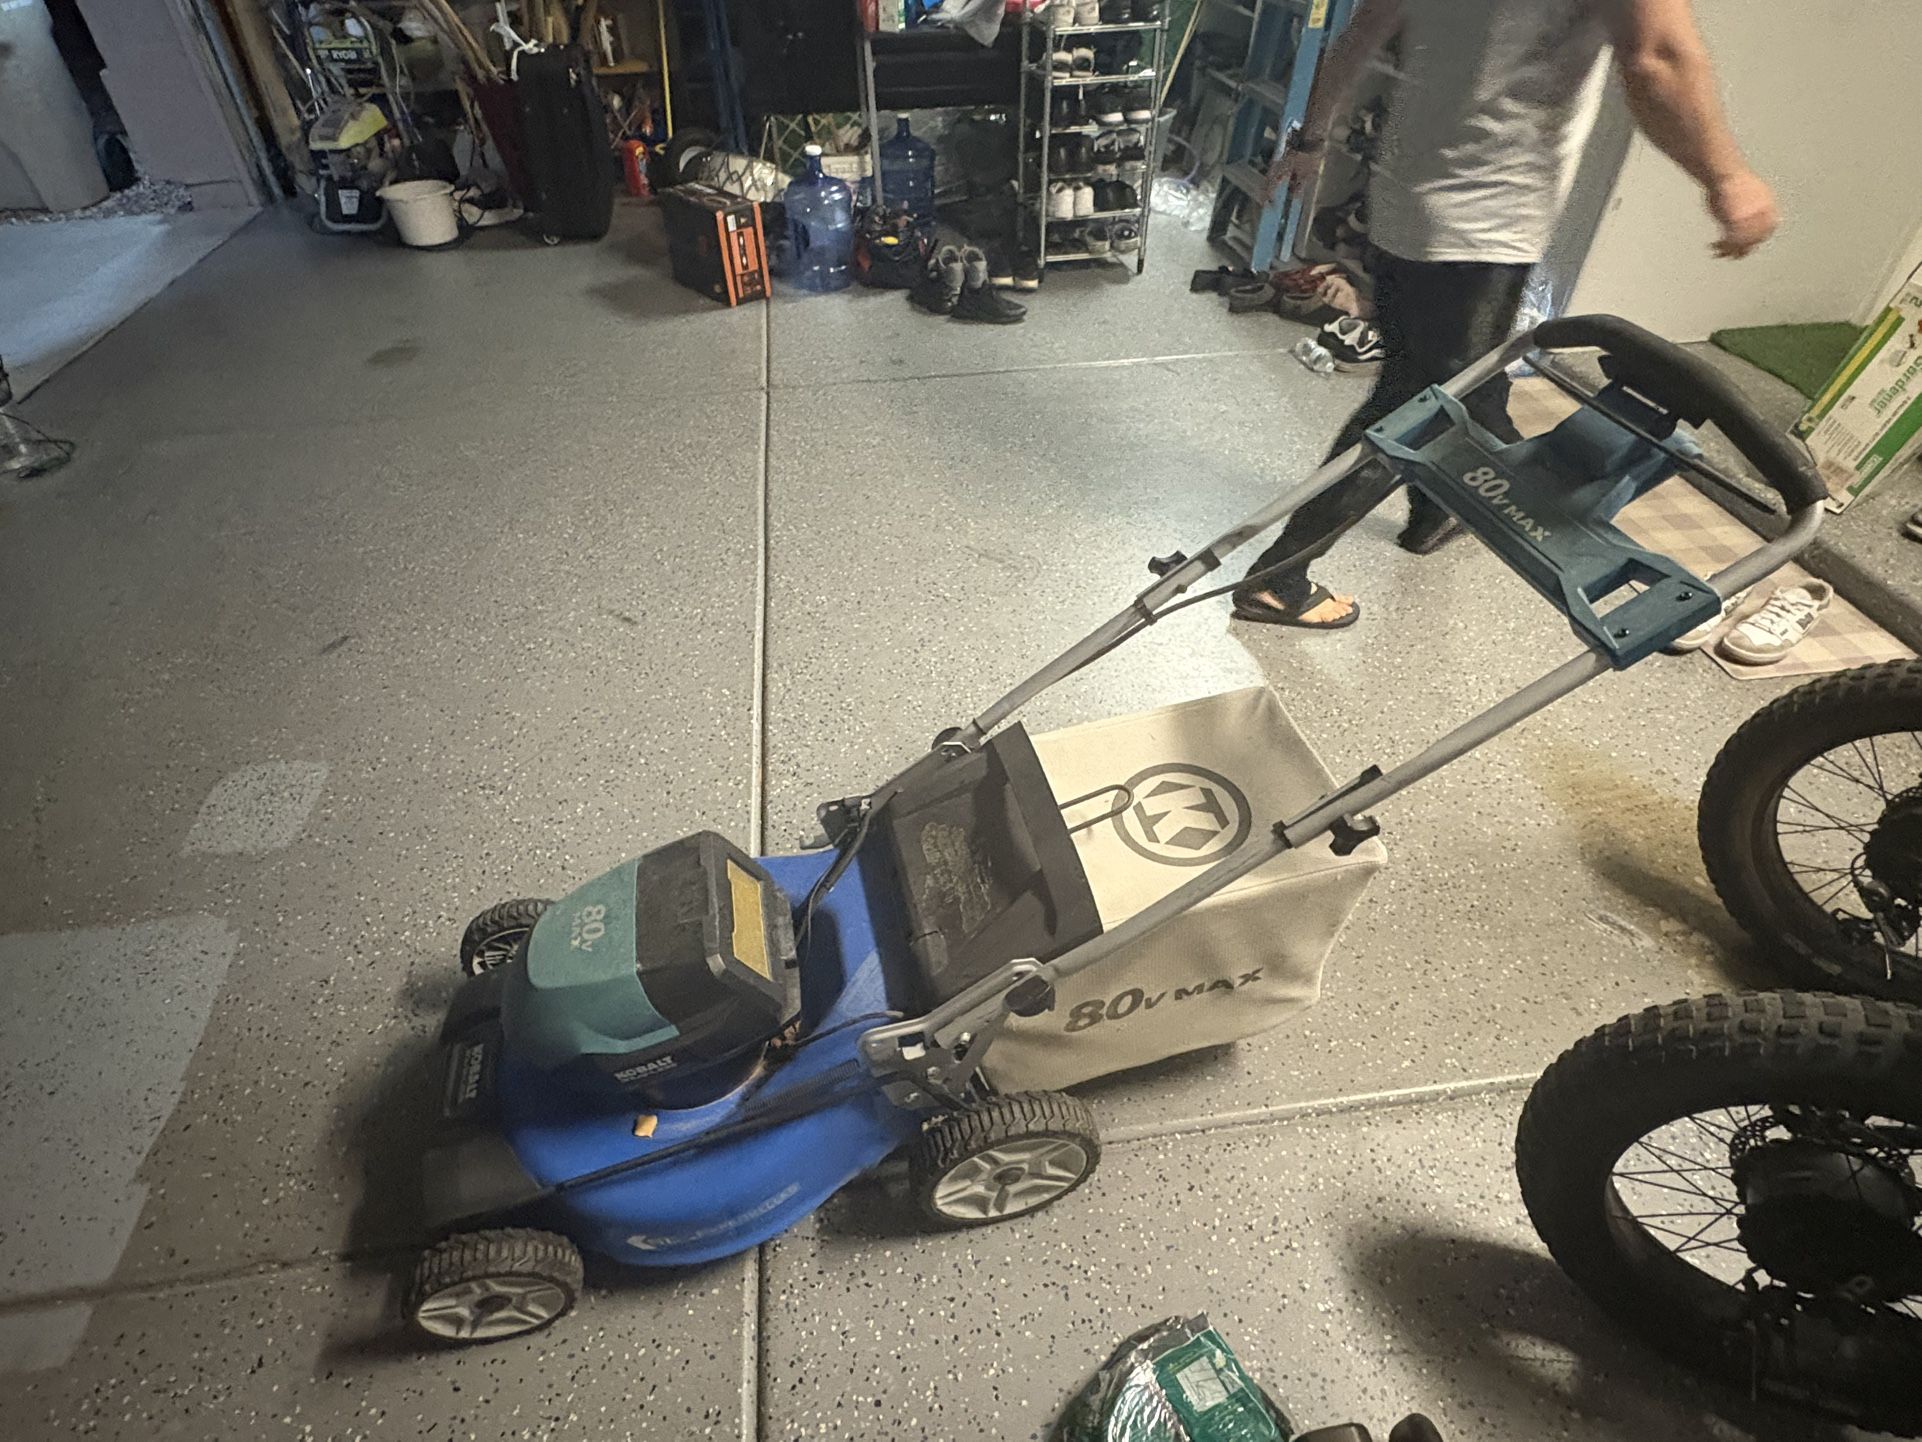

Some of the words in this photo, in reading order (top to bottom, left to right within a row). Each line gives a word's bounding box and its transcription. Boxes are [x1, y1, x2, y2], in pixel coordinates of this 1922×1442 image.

[1503, 505, 1552, 542] MAX
[1174, 967, 1264, 1001] MAX
[614, 1056, 673, 1079] KOBALT
